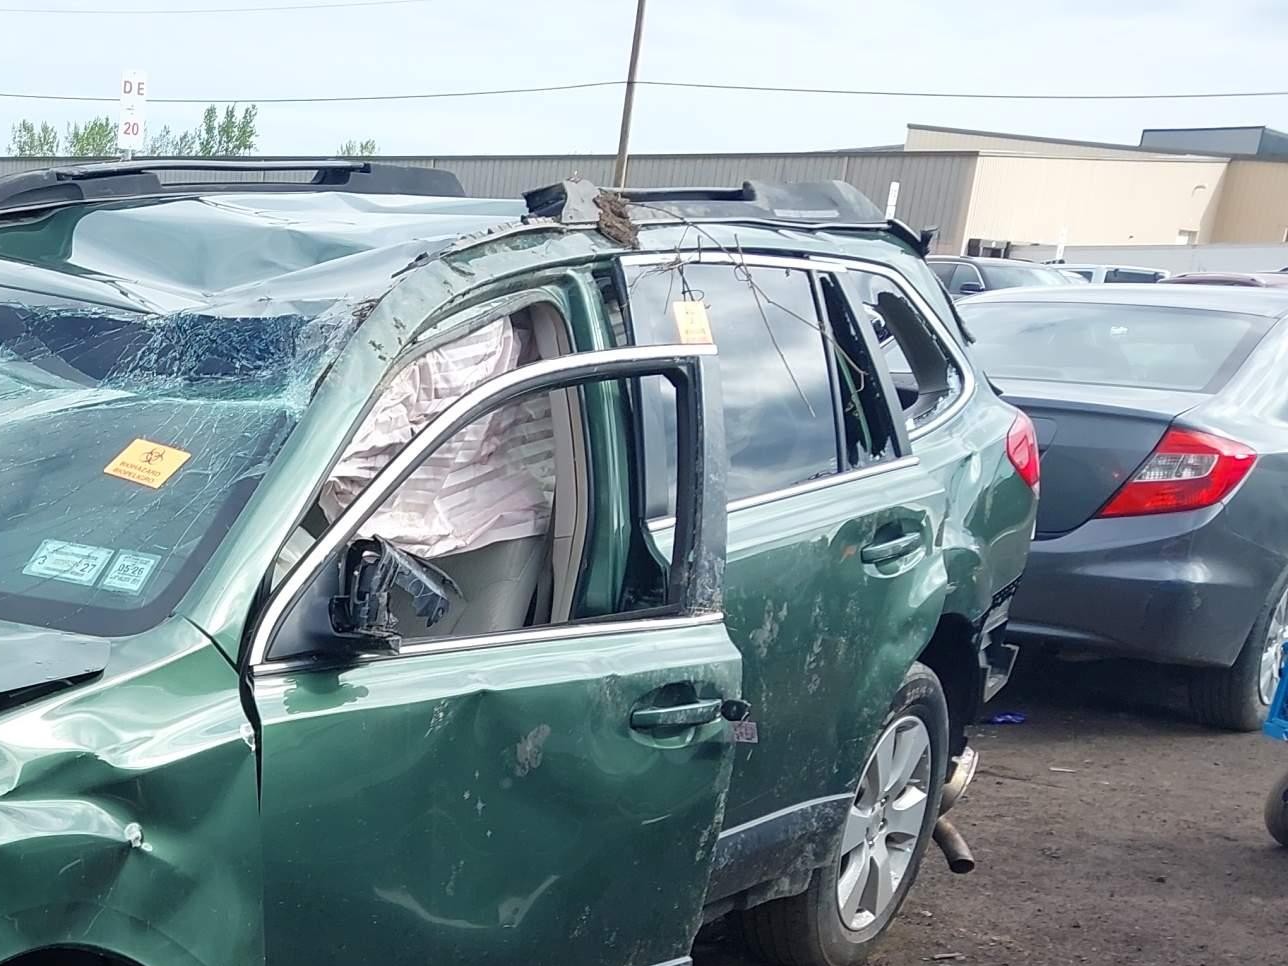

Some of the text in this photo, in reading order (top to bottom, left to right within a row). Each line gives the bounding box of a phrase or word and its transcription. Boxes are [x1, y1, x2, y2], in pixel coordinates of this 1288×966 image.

[123, 121, 139, 136] 20
[119, 460, 161, 477] BIOHAZARD
[80, 562, 98, 574] 27
